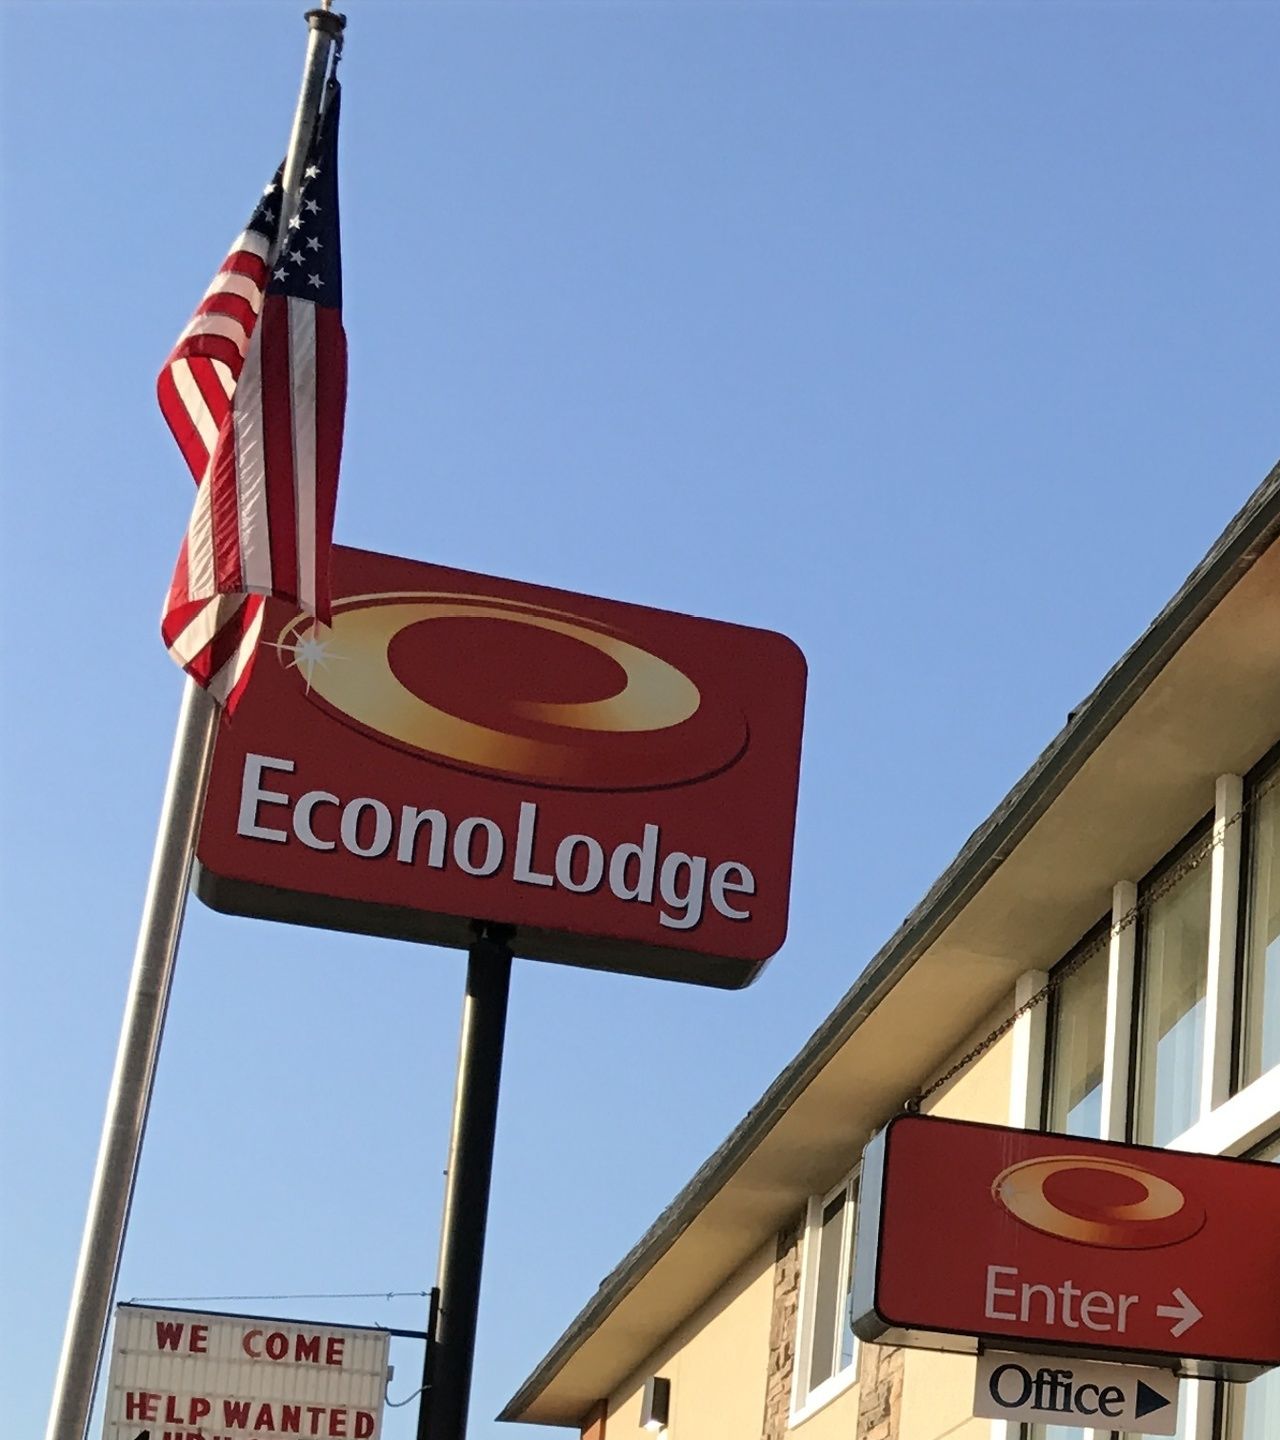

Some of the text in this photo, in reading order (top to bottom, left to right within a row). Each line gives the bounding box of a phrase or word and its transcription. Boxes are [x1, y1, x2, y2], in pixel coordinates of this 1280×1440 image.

[235, 751, 756, 930] EconoLodge
[984, 1264, 1139, 1334] Enter
[156, 1321, 345, 1366] WE COME
[126, 1391, 375, 1439] HELP WANTED
[988, 1363, 1126, 1418] Office
